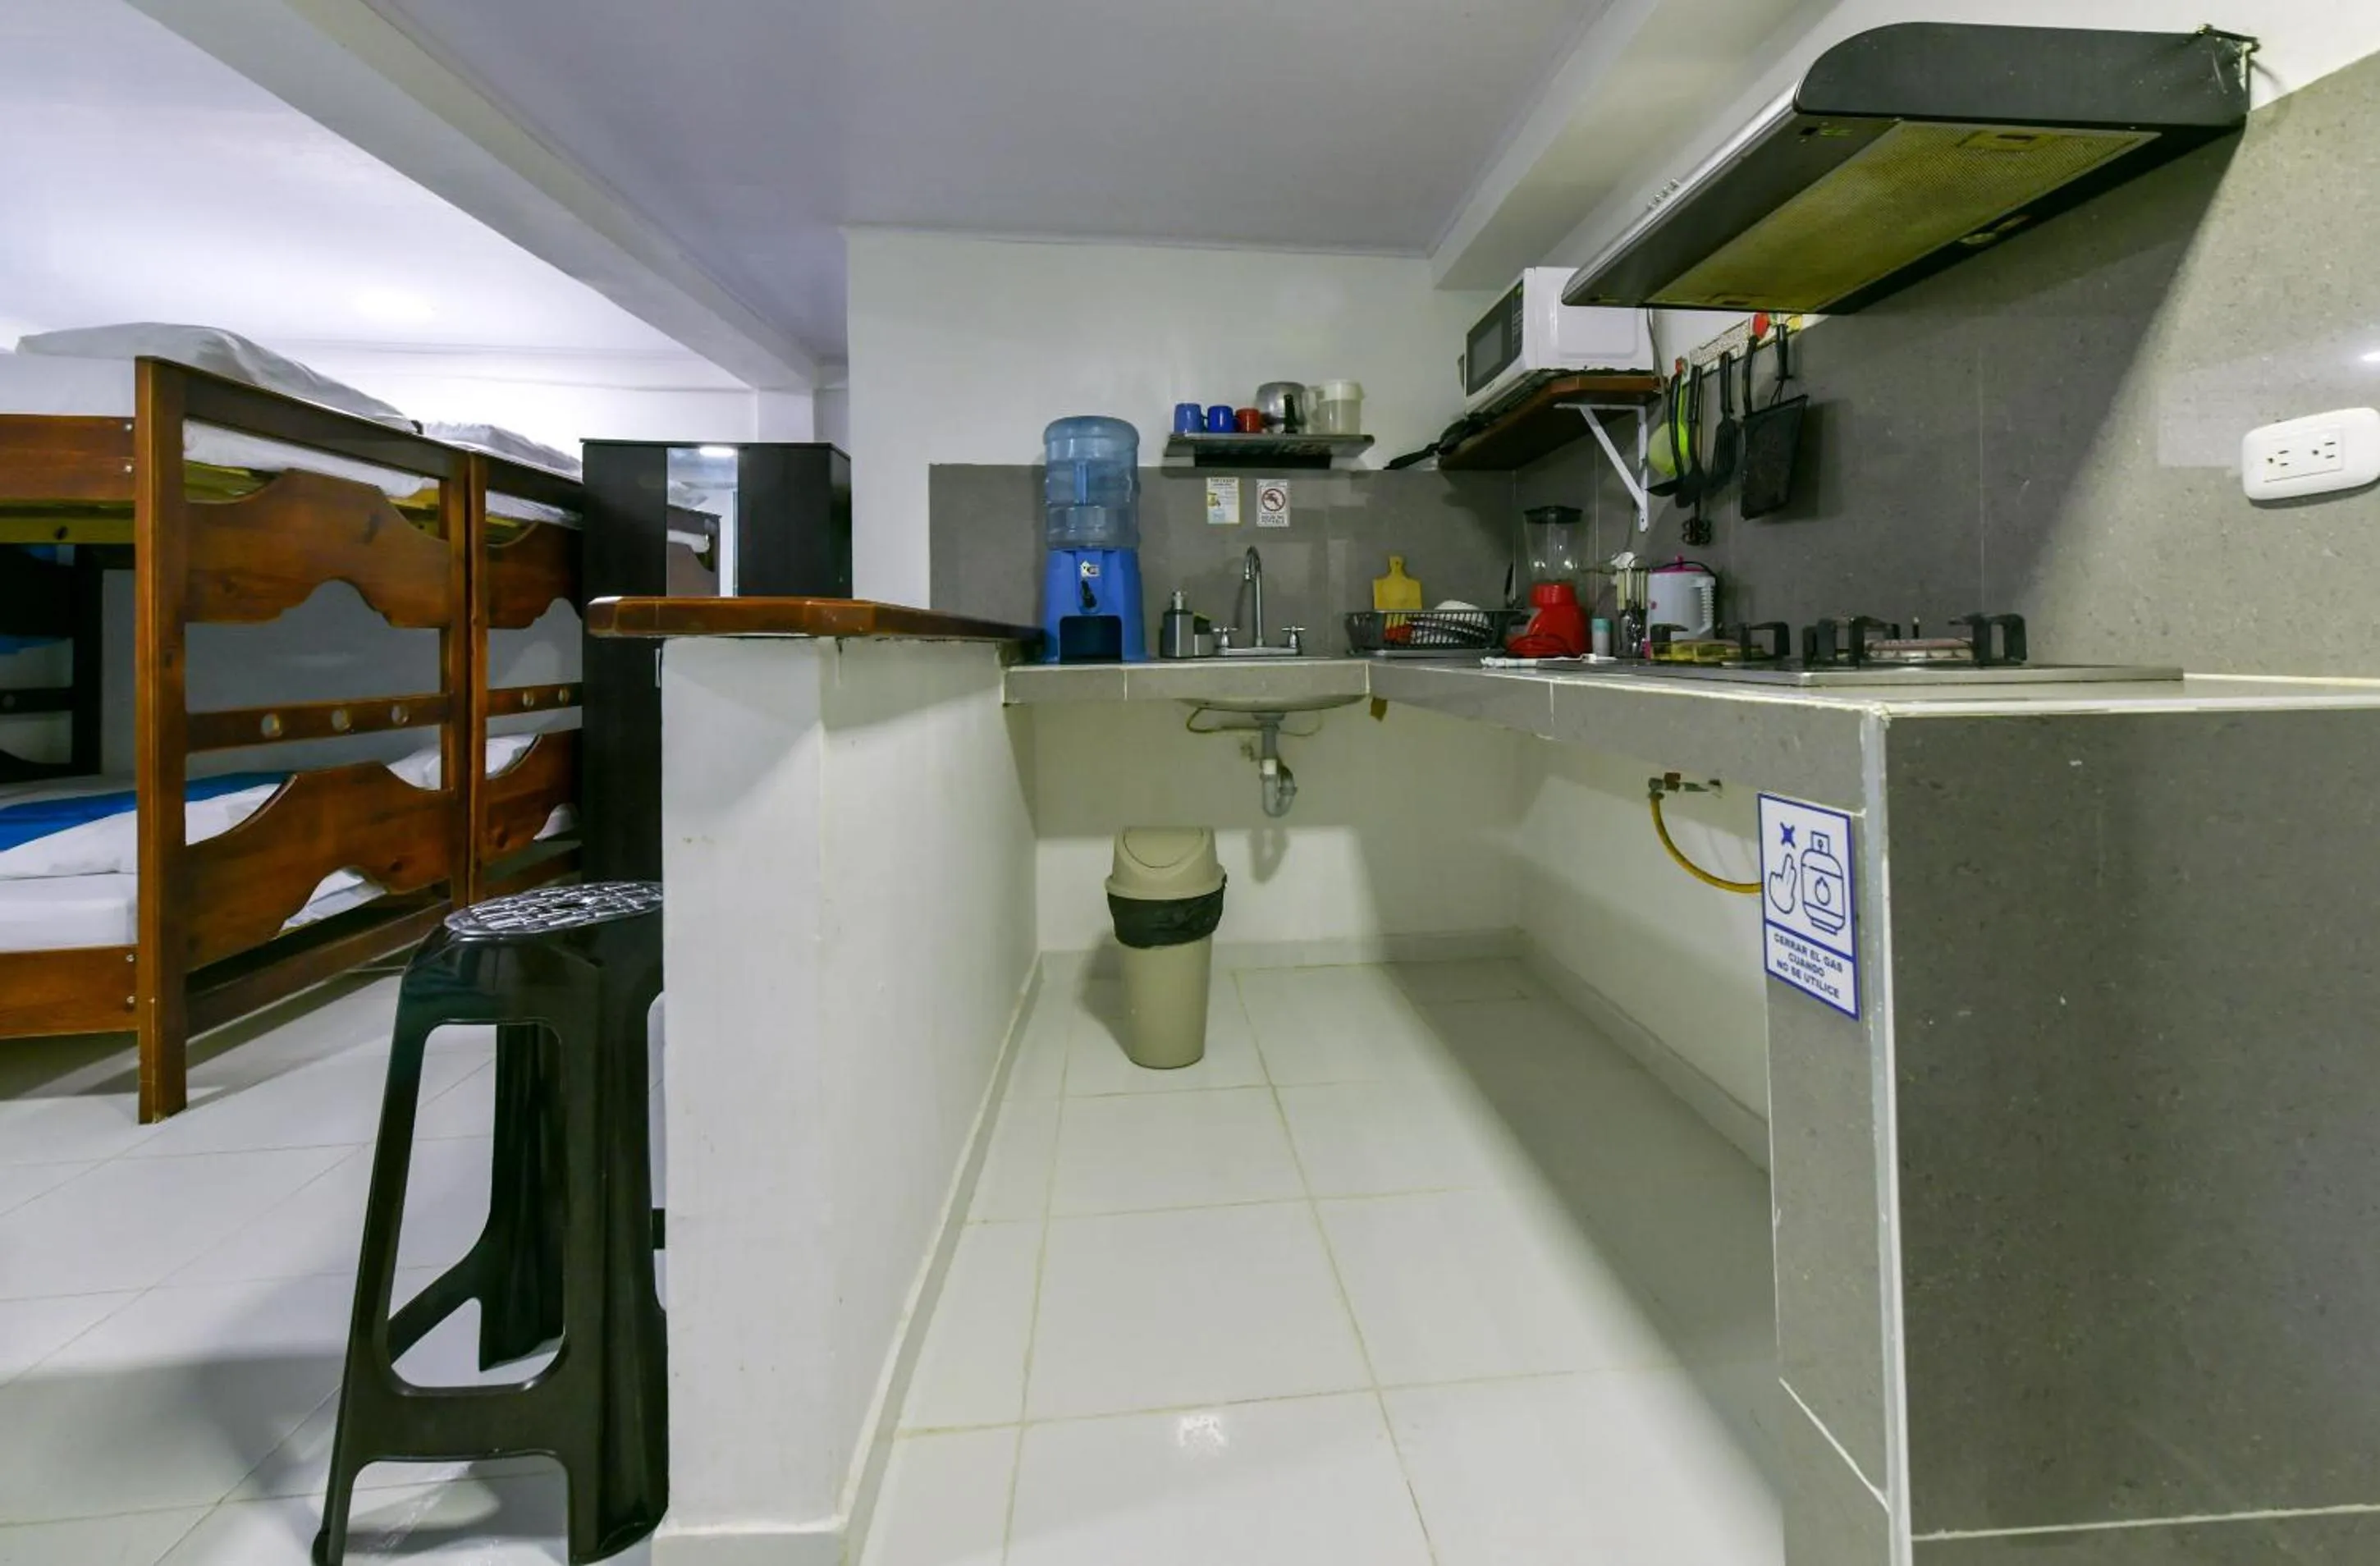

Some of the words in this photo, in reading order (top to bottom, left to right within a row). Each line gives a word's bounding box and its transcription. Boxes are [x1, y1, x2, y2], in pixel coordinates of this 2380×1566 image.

[1787, 952, 1825, 978] CUANDO
[1810, 950, 1821, 962] EL
[1823, 955, 1843, 973] GAS
[1776, 959, 1789, 972] NO
[1791, 966, 1802, 980] SE
[1803, 973, 1840, 1000] UTILICE
